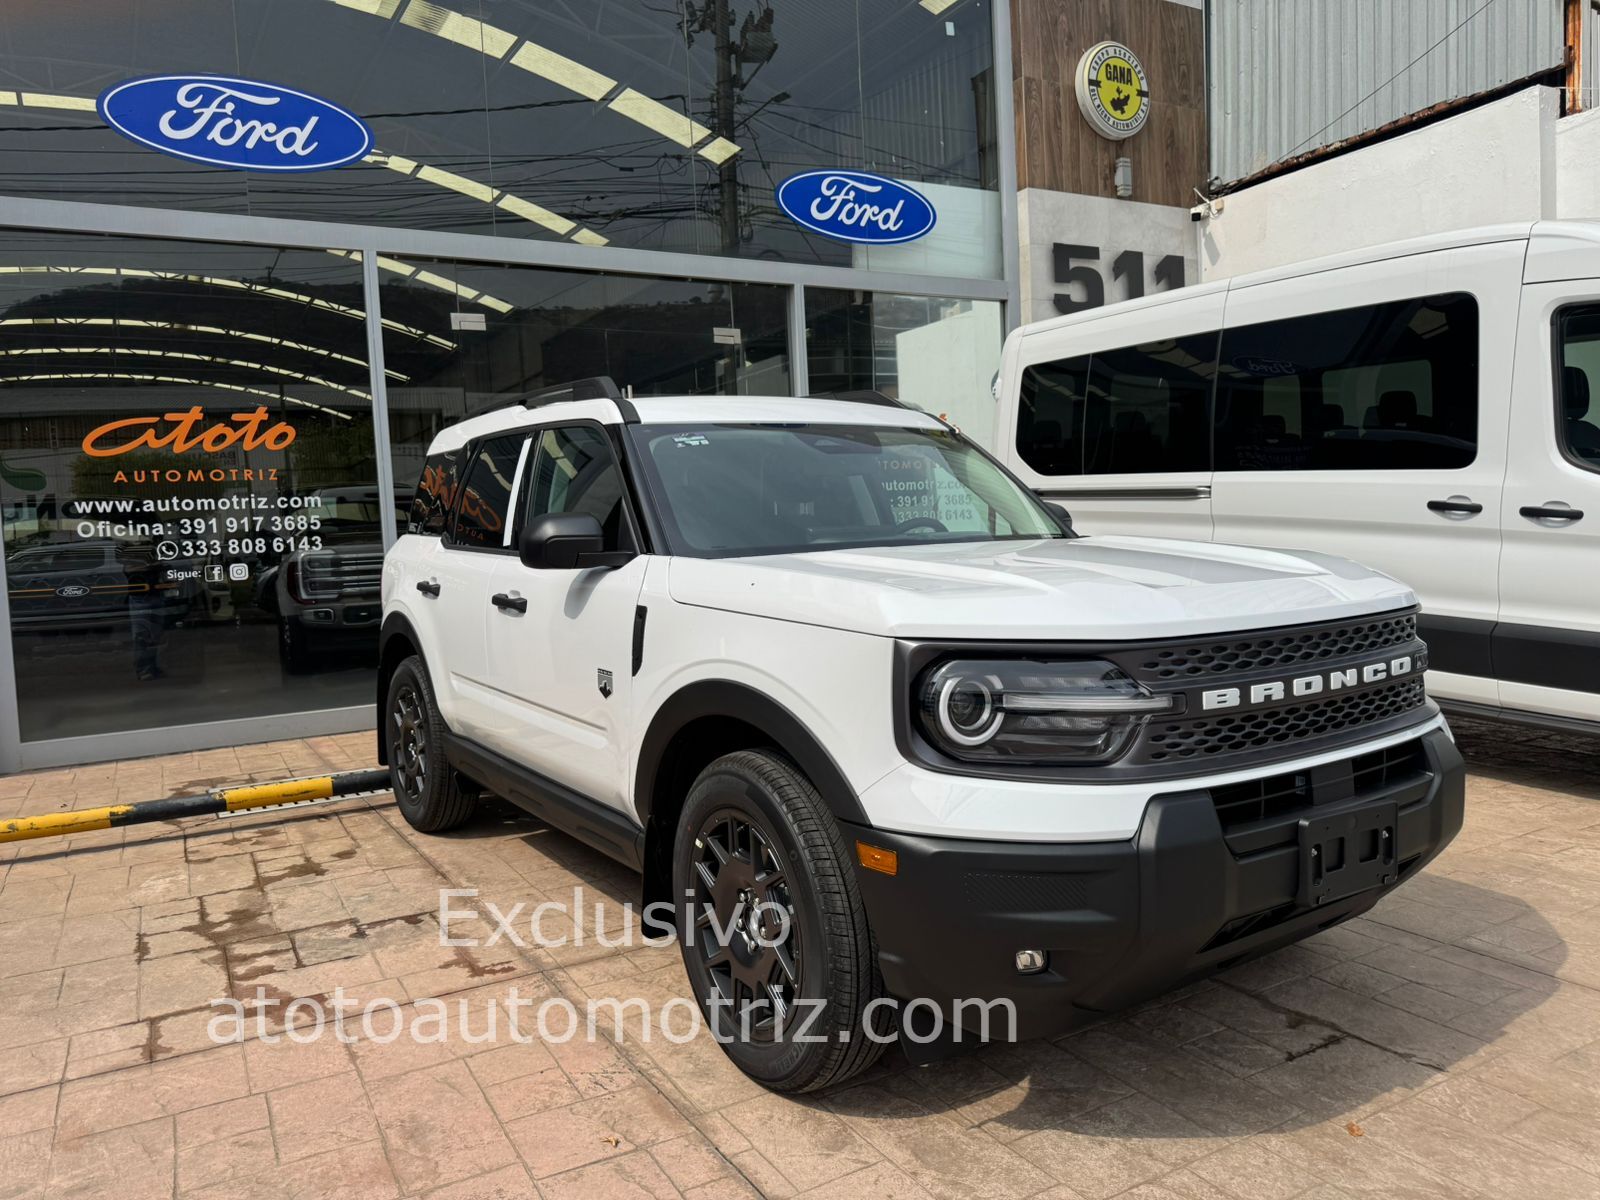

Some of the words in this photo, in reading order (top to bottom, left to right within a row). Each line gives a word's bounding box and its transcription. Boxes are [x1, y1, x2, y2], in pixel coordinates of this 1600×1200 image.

[1105, 63, 1133, 86] GANA
[158, 82, 319, 156] Ford
[810, 175, 904, 232] Ford
[1053, 242, 1185, 315] 511
[81, 405, 296, 457] atoto
[113, 468, 279, 483] AUTOMOTRIZ
[74, 494, 322, 514] www.automotriz.com
[76, 520, 173, 538] Oficina:
[179, 518, 218, 535] 391
[226, 516, 264, 534] 917
[271, 514, 321, 531] 3685
[182, 540, 222, 557] 333
[228, 538, 267, 555] 808
[272, 536, 322, 552] 6143
[166, 569, 202, 580] Sigue:
[1202, 656, 1412, 710] BRONCO
